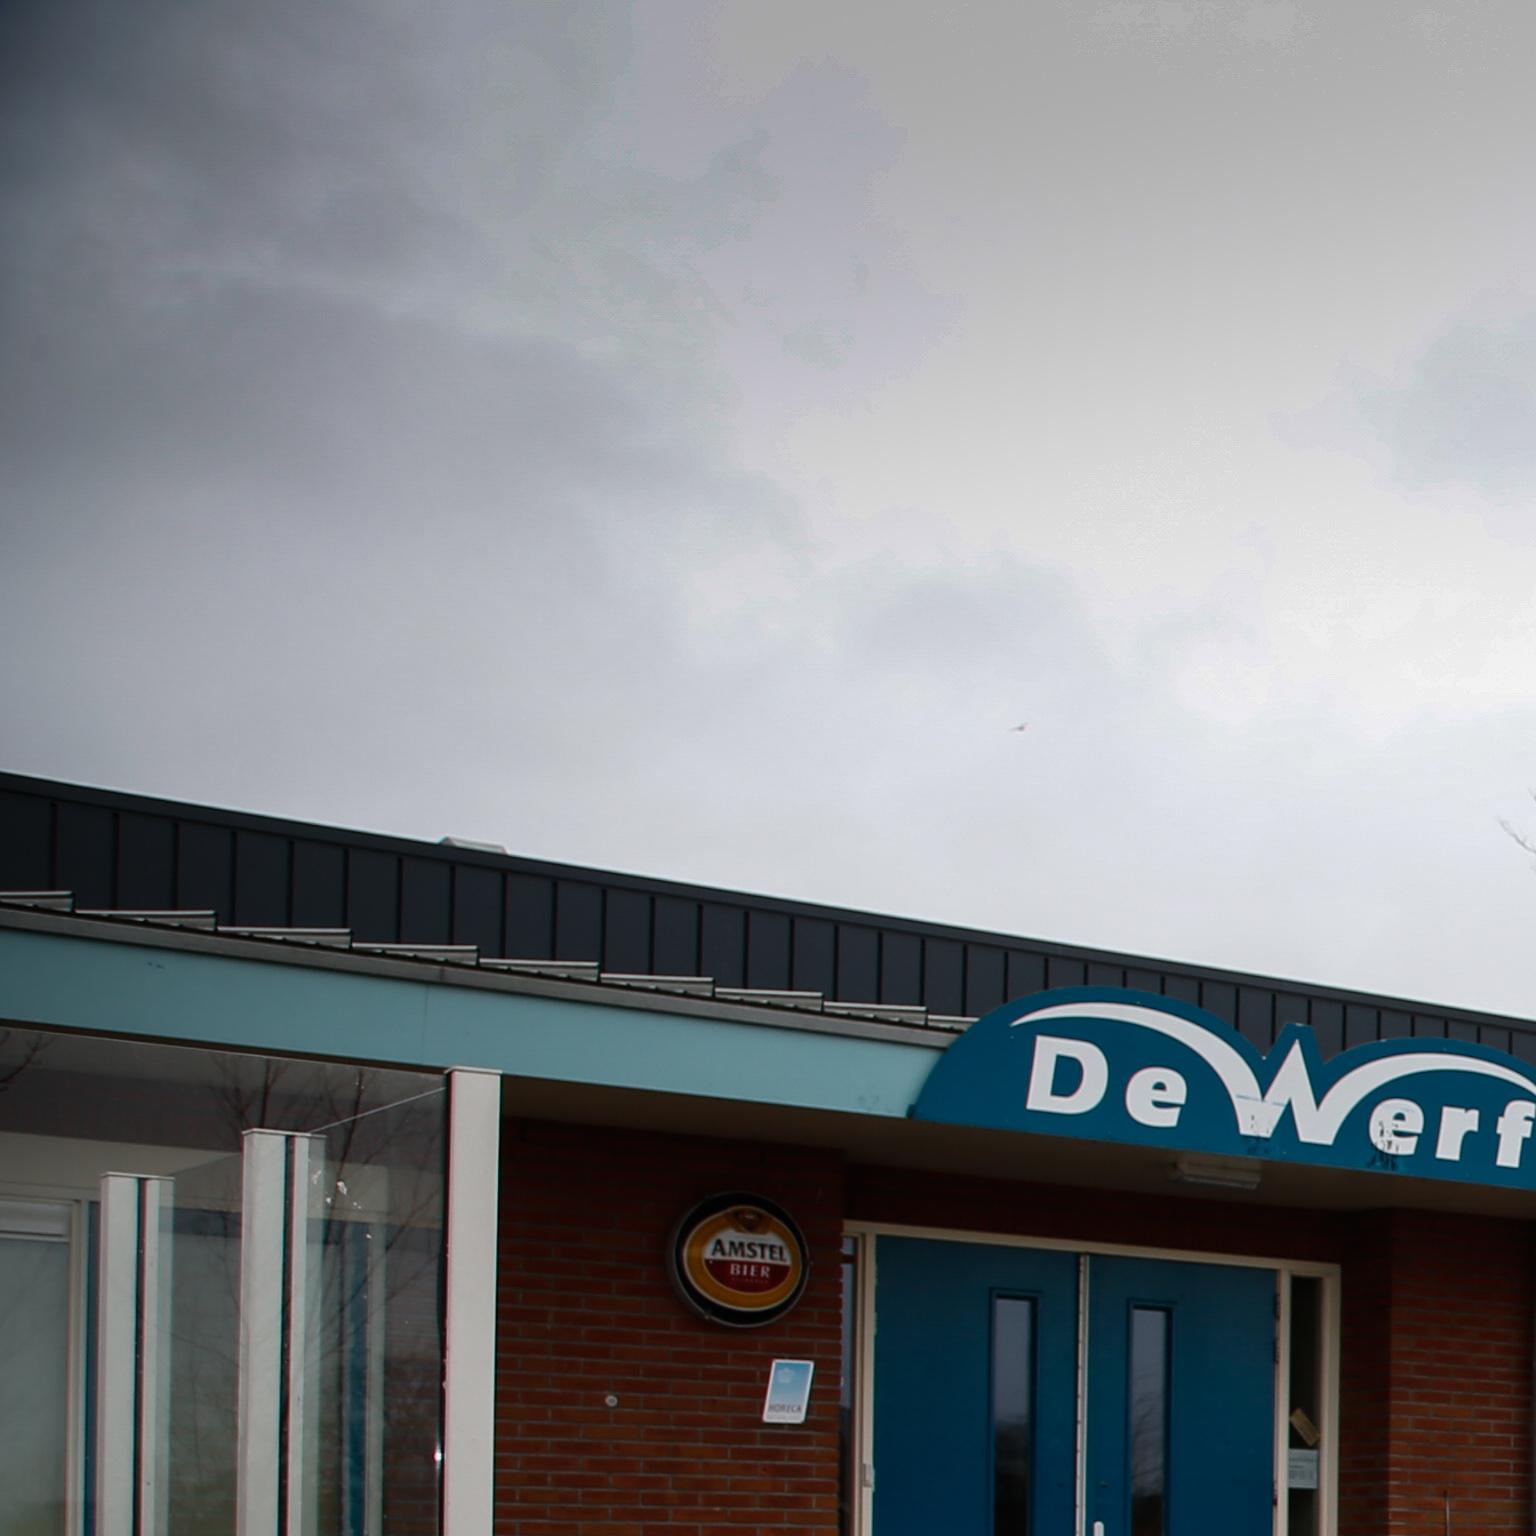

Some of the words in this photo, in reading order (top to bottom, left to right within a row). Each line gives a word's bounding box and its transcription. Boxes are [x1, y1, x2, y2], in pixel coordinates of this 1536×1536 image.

[1026, 1034, 1188, 1129] De
[711, 1238, 787, 1262] AMSTEL
[730, 1263, 771, 1279] BIER
